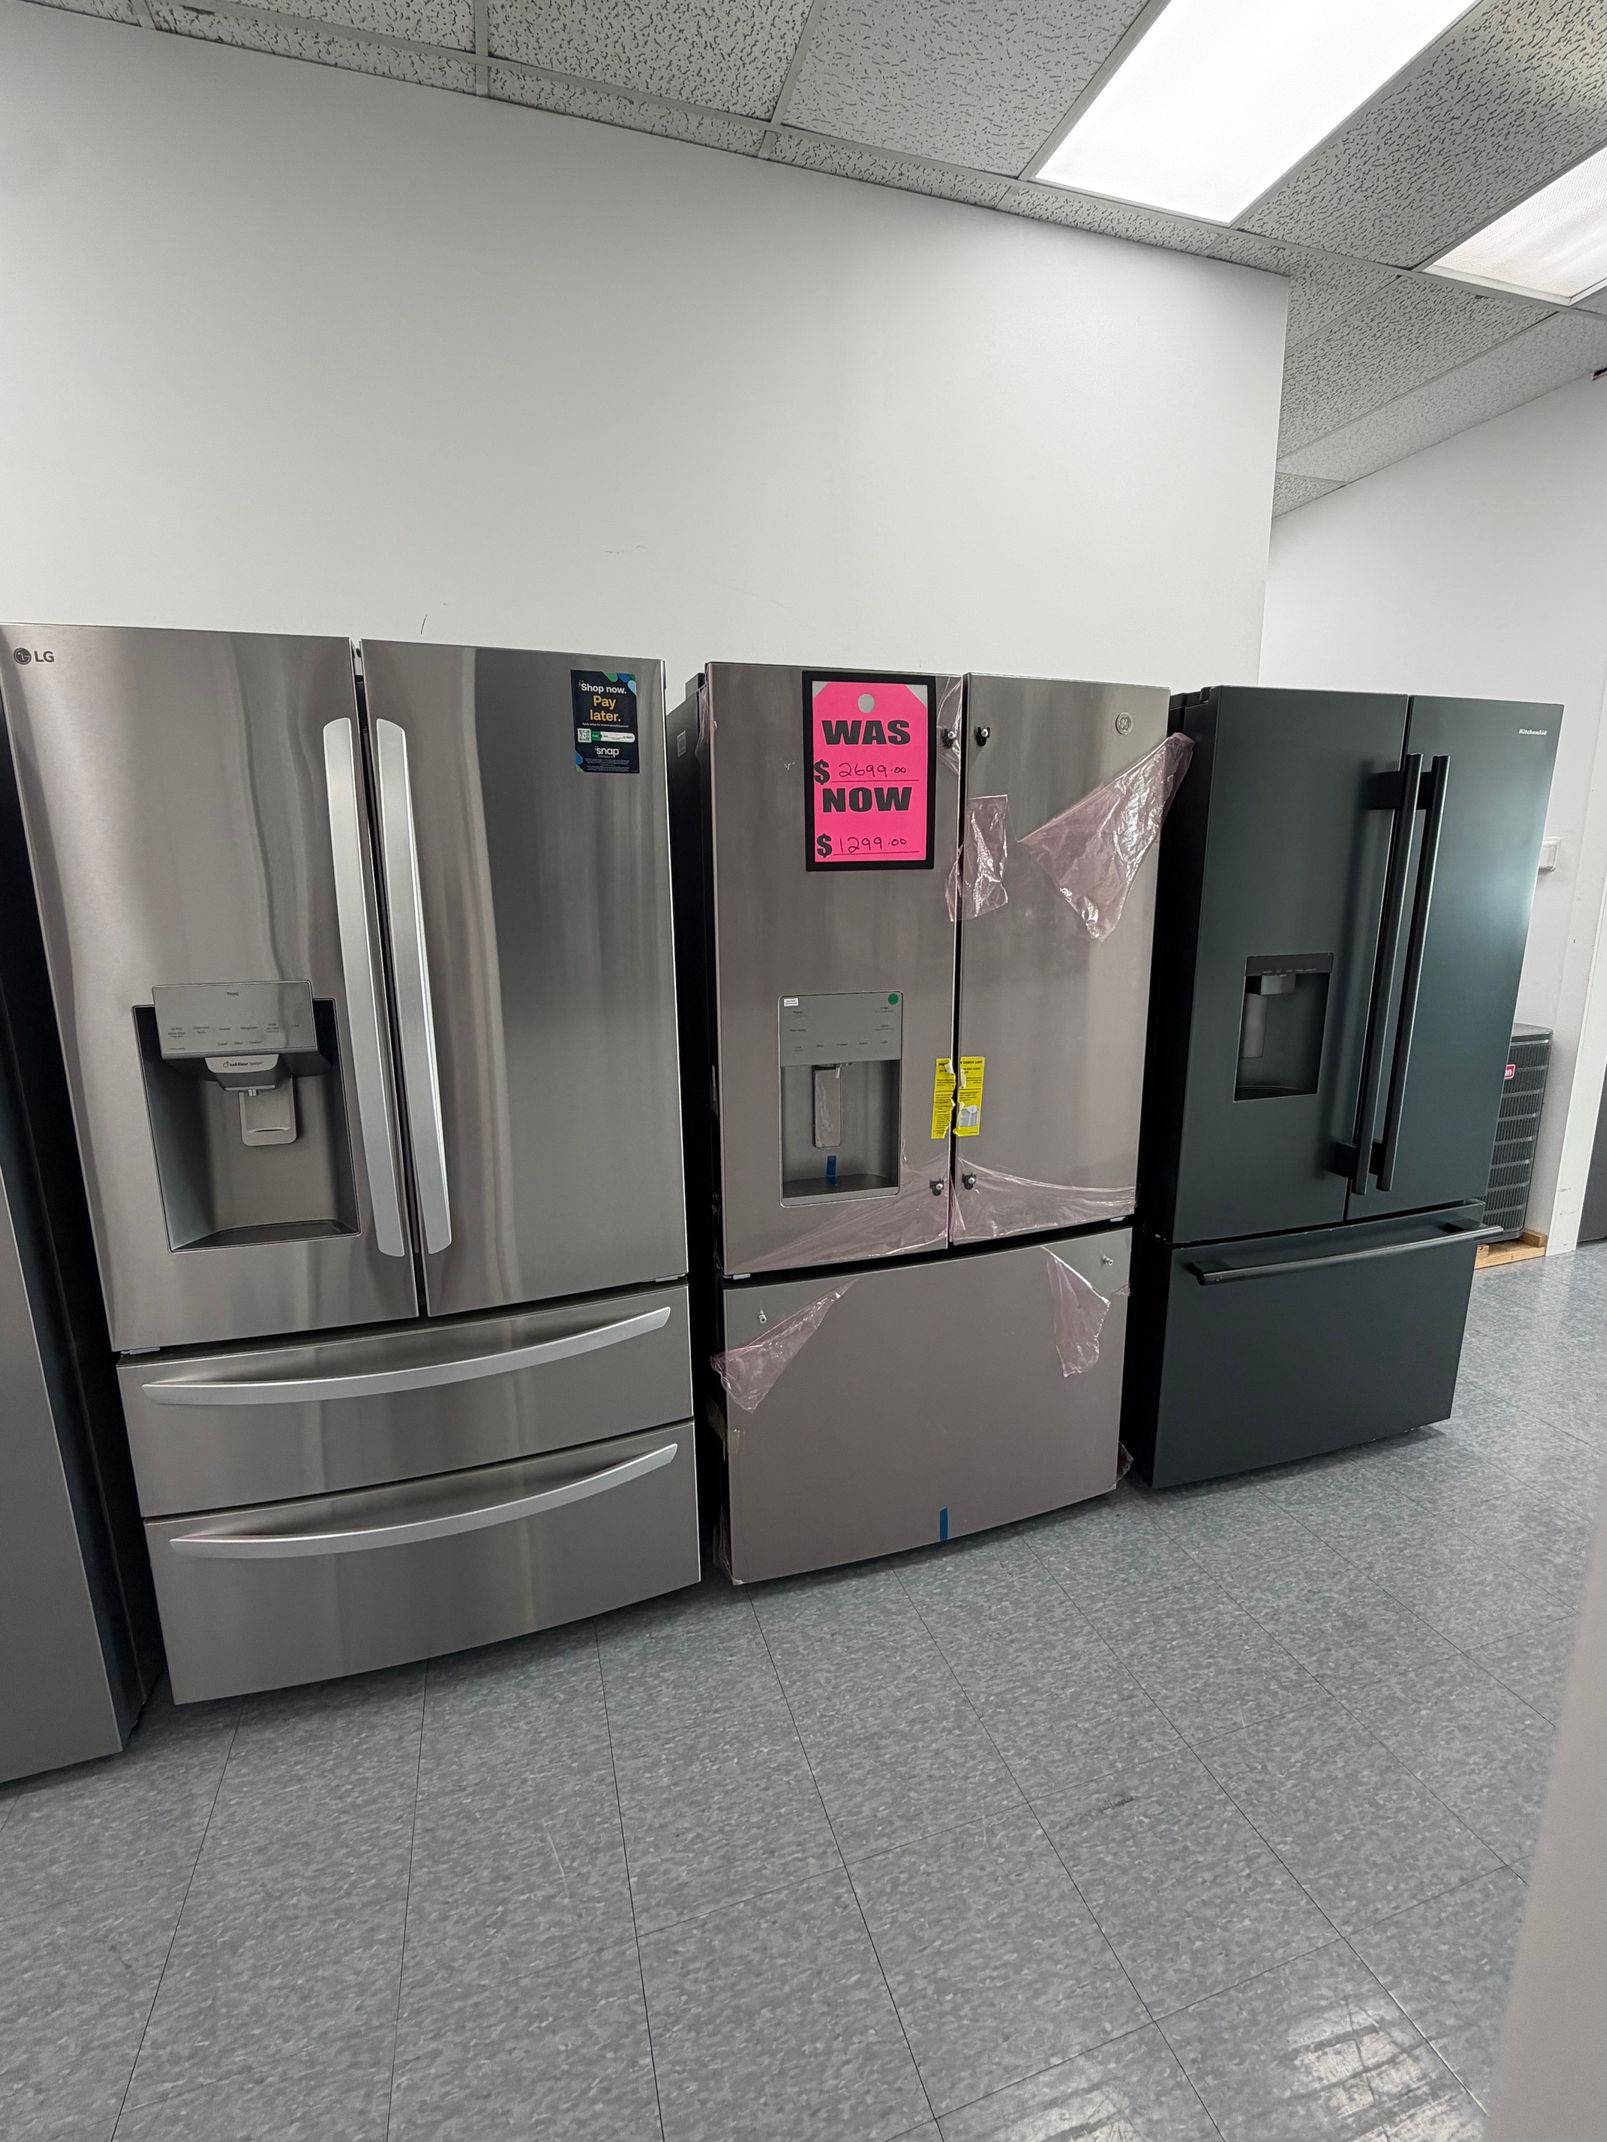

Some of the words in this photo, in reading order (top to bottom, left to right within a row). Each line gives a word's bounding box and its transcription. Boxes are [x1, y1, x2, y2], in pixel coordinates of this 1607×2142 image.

[34, 650, 55, 663] LG
[581, 682, 604, 694] Shop
[606, 686, 627, 694] now.
[593, 695, 616, 710] Pay
[590, 709, 621, 722] later.
[821, 719, 911, 746] WAS
[596, 747, 620, 758] snap
[822, 786, 913, 813] NOW
